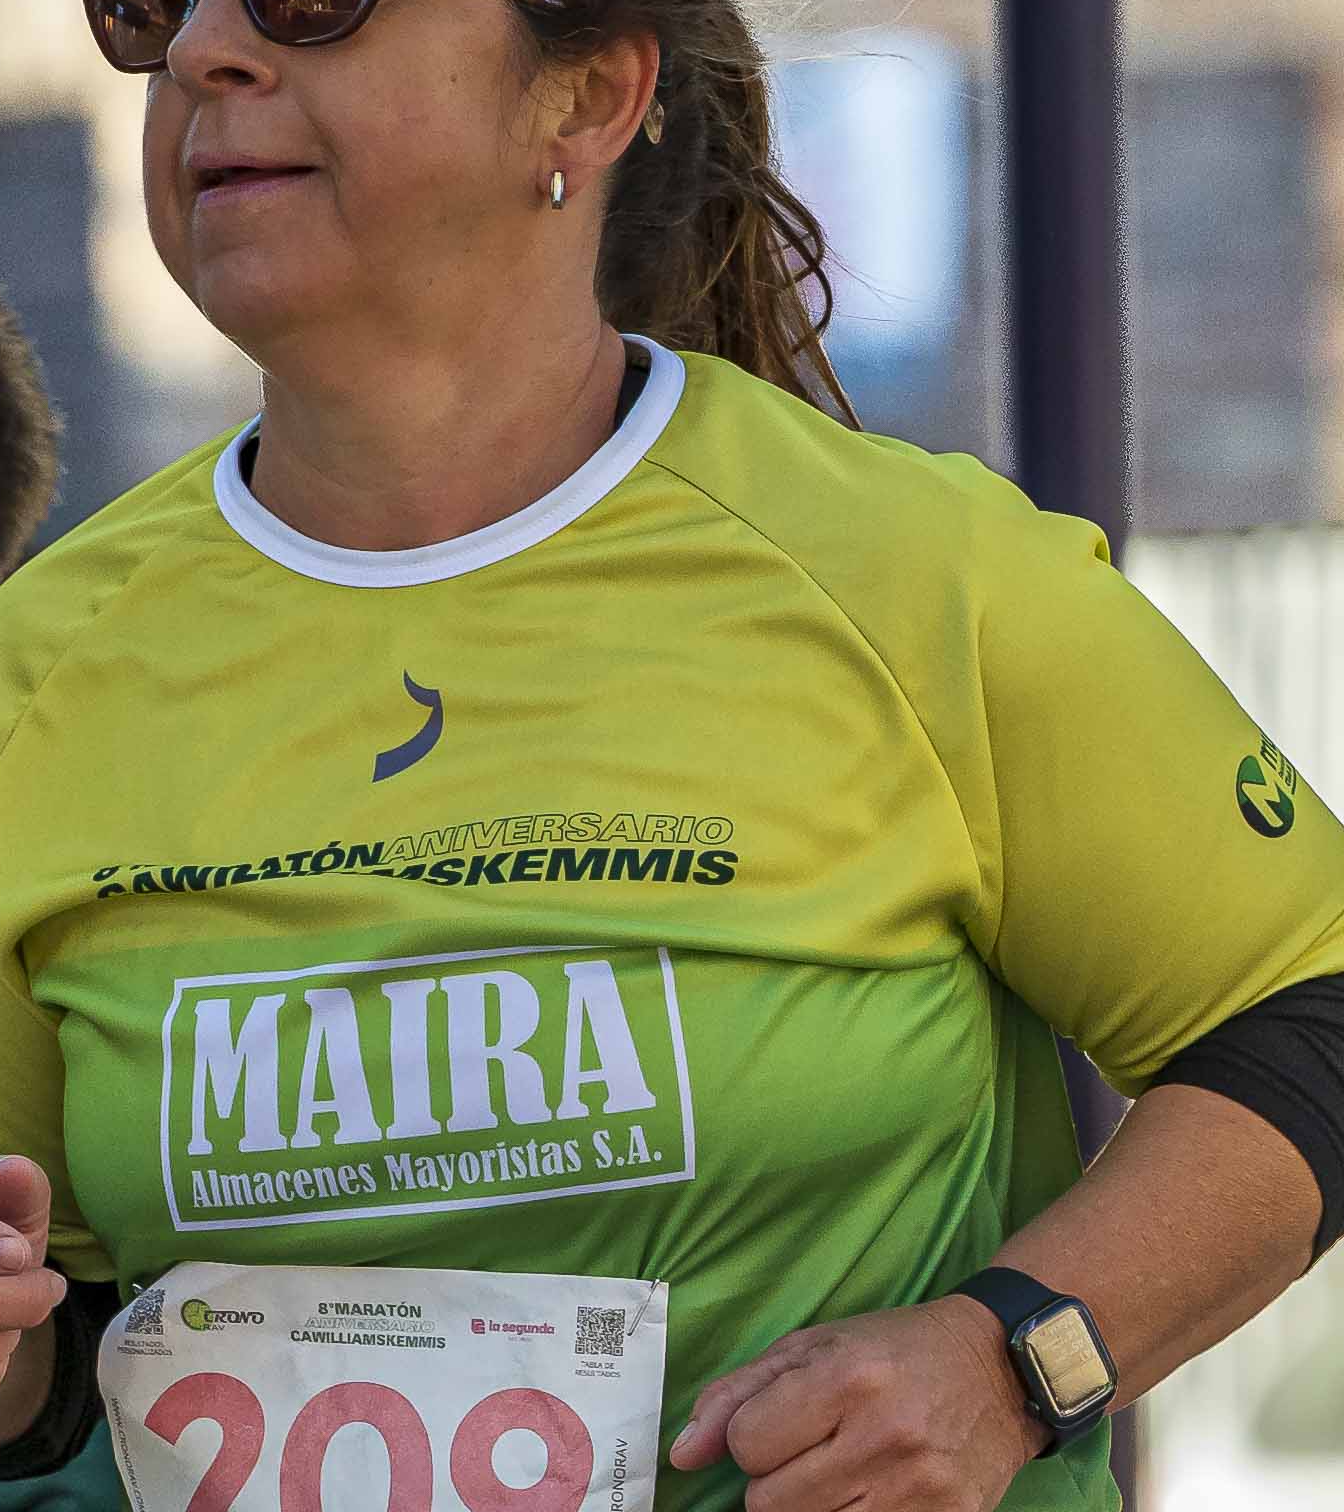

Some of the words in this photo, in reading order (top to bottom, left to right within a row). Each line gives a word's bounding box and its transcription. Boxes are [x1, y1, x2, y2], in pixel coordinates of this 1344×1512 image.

[381, 812, 735, 865] ANIVERSARIO
[187, 959, 656, 1155] MAIRA
[190, 1159, 377, 1208] Almacenes
[383, 1137, 582, 1193] Mayoristas
[592, 1125, 663, 1170] S.A.
[290, 1330, 446, 1349] CAWILLIAMSKEMMIS
[488, 1319, 501, 1332] la
[502, 1322, 555, 1335] segunda
